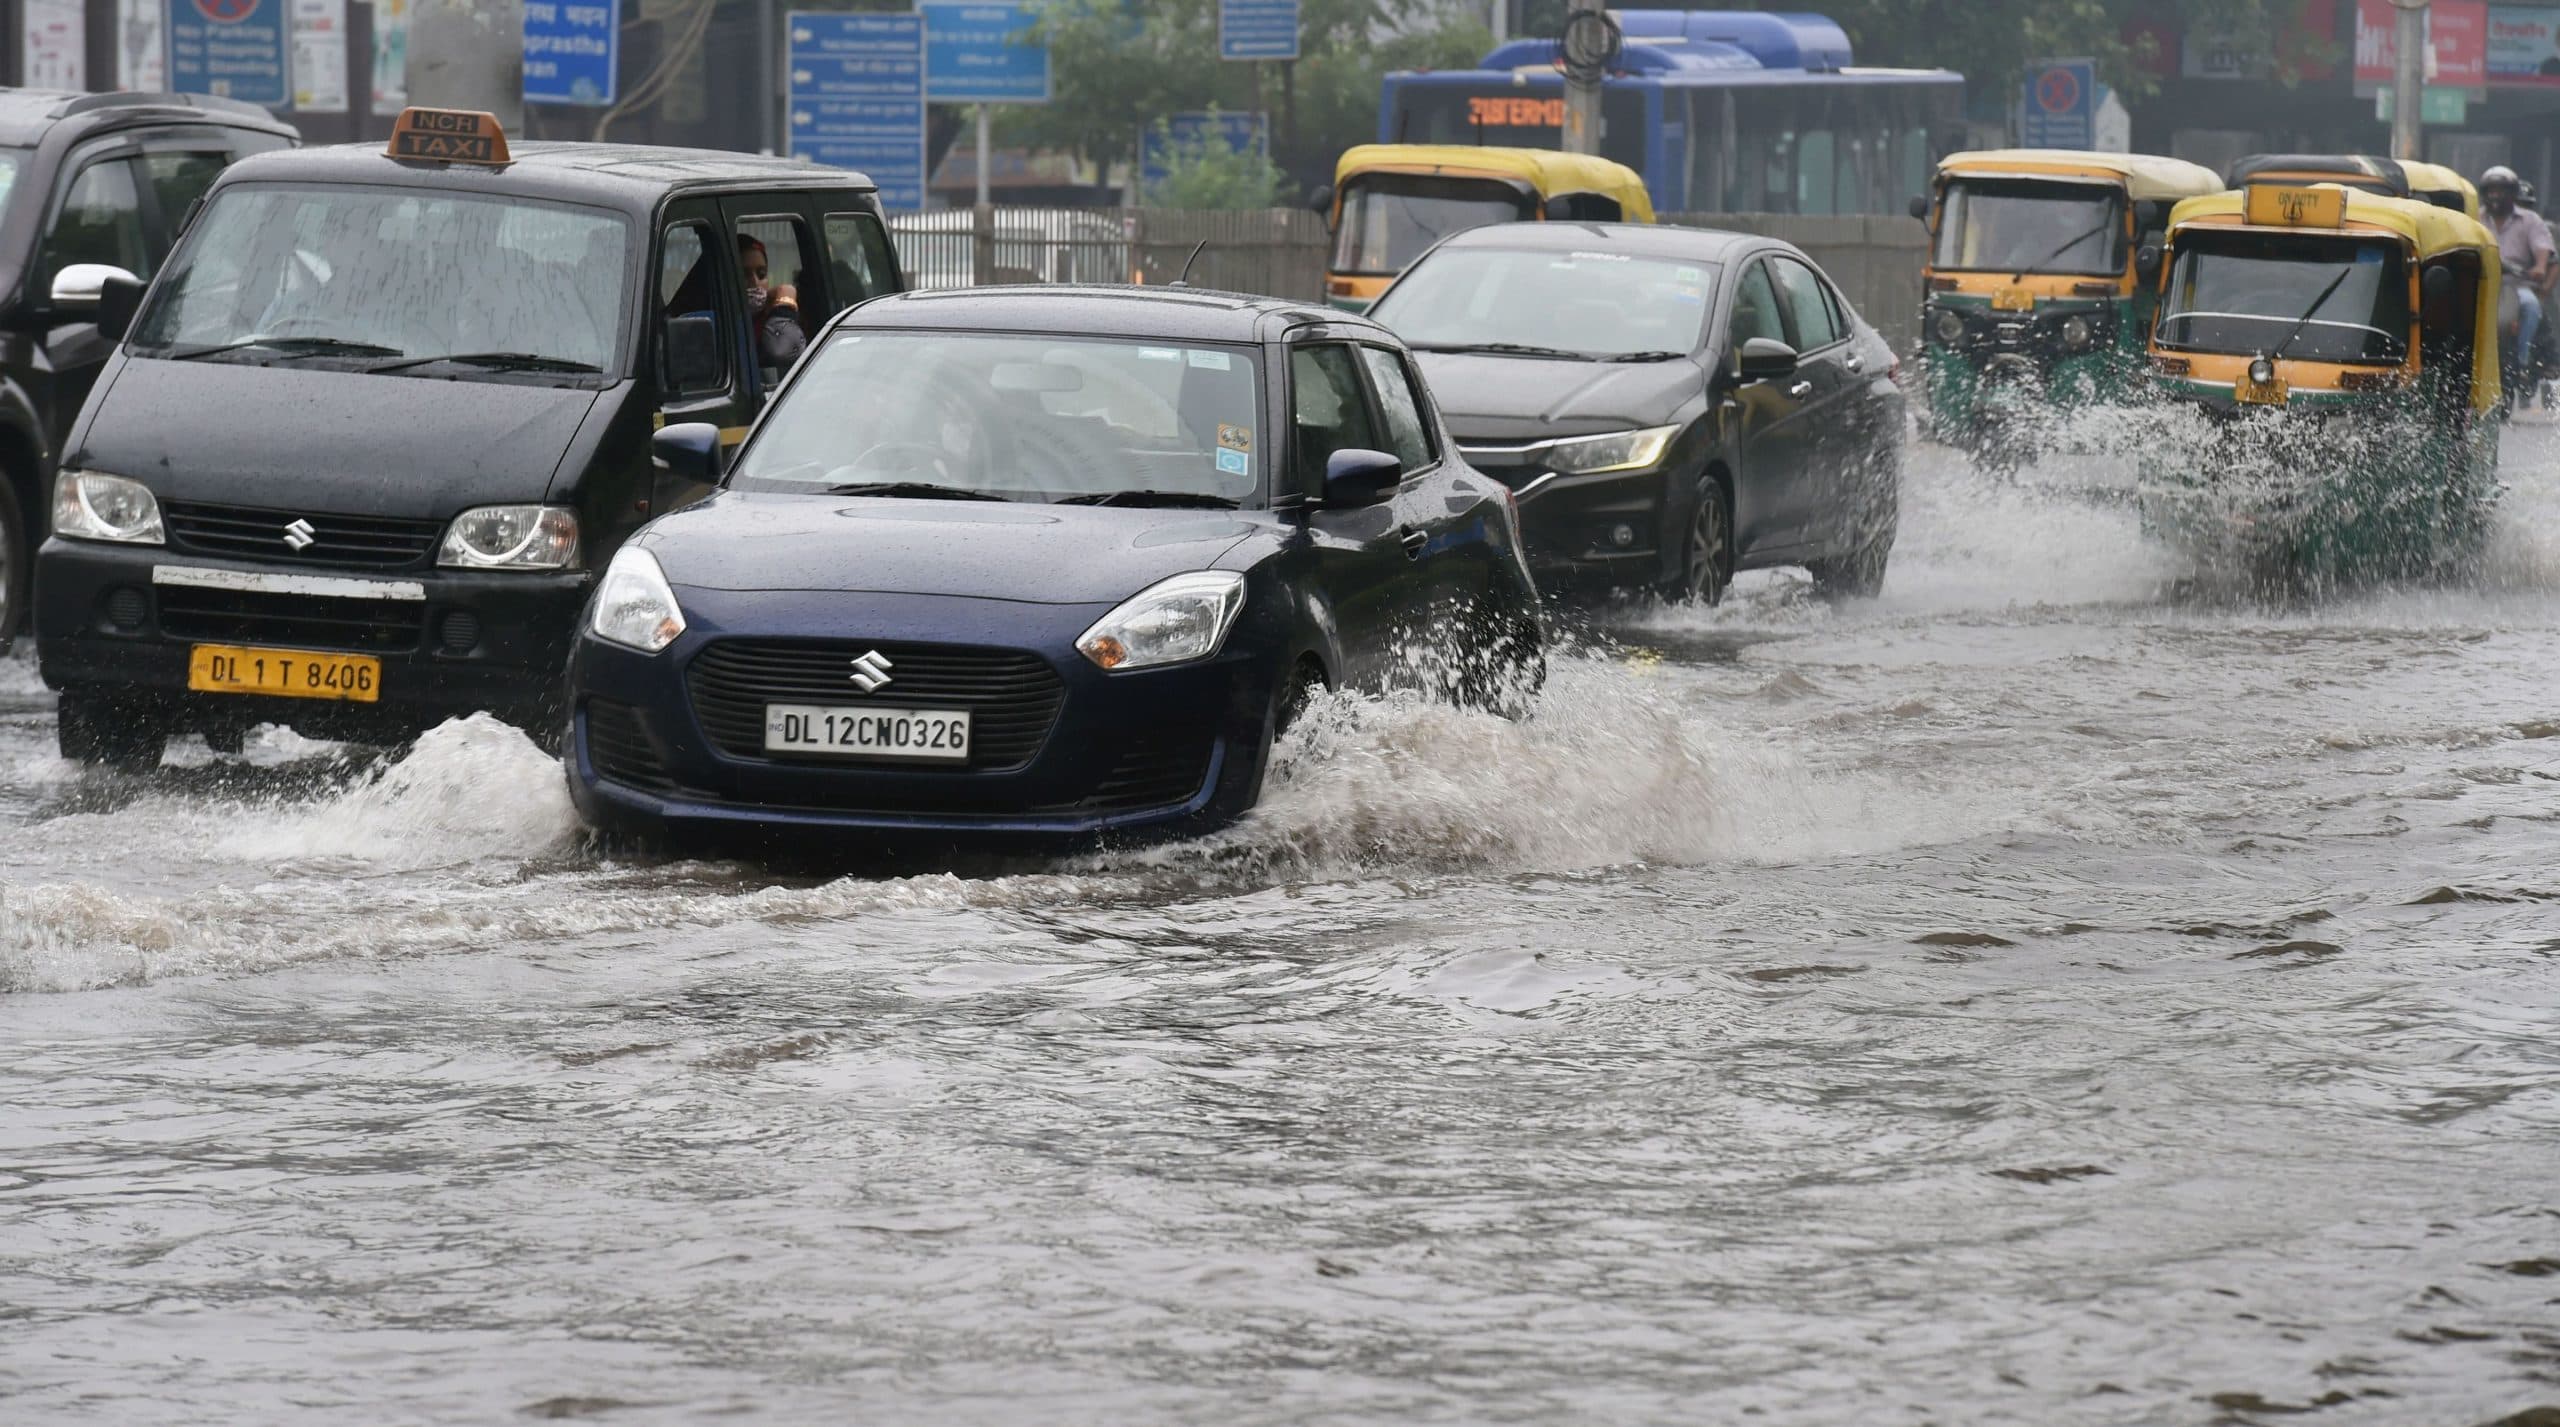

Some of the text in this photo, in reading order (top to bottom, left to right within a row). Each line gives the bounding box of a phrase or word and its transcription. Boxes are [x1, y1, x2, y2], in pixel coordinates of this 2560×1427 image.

[408, 135, 485, 156] TAXI
[211, 655, 241, 682] DL
[255, 658, 265, 685] 1
[279, 659, 294, 687] T
[307, 663, 372, 690] 8406
[784, 713, 965, 749] DL12CN0326
